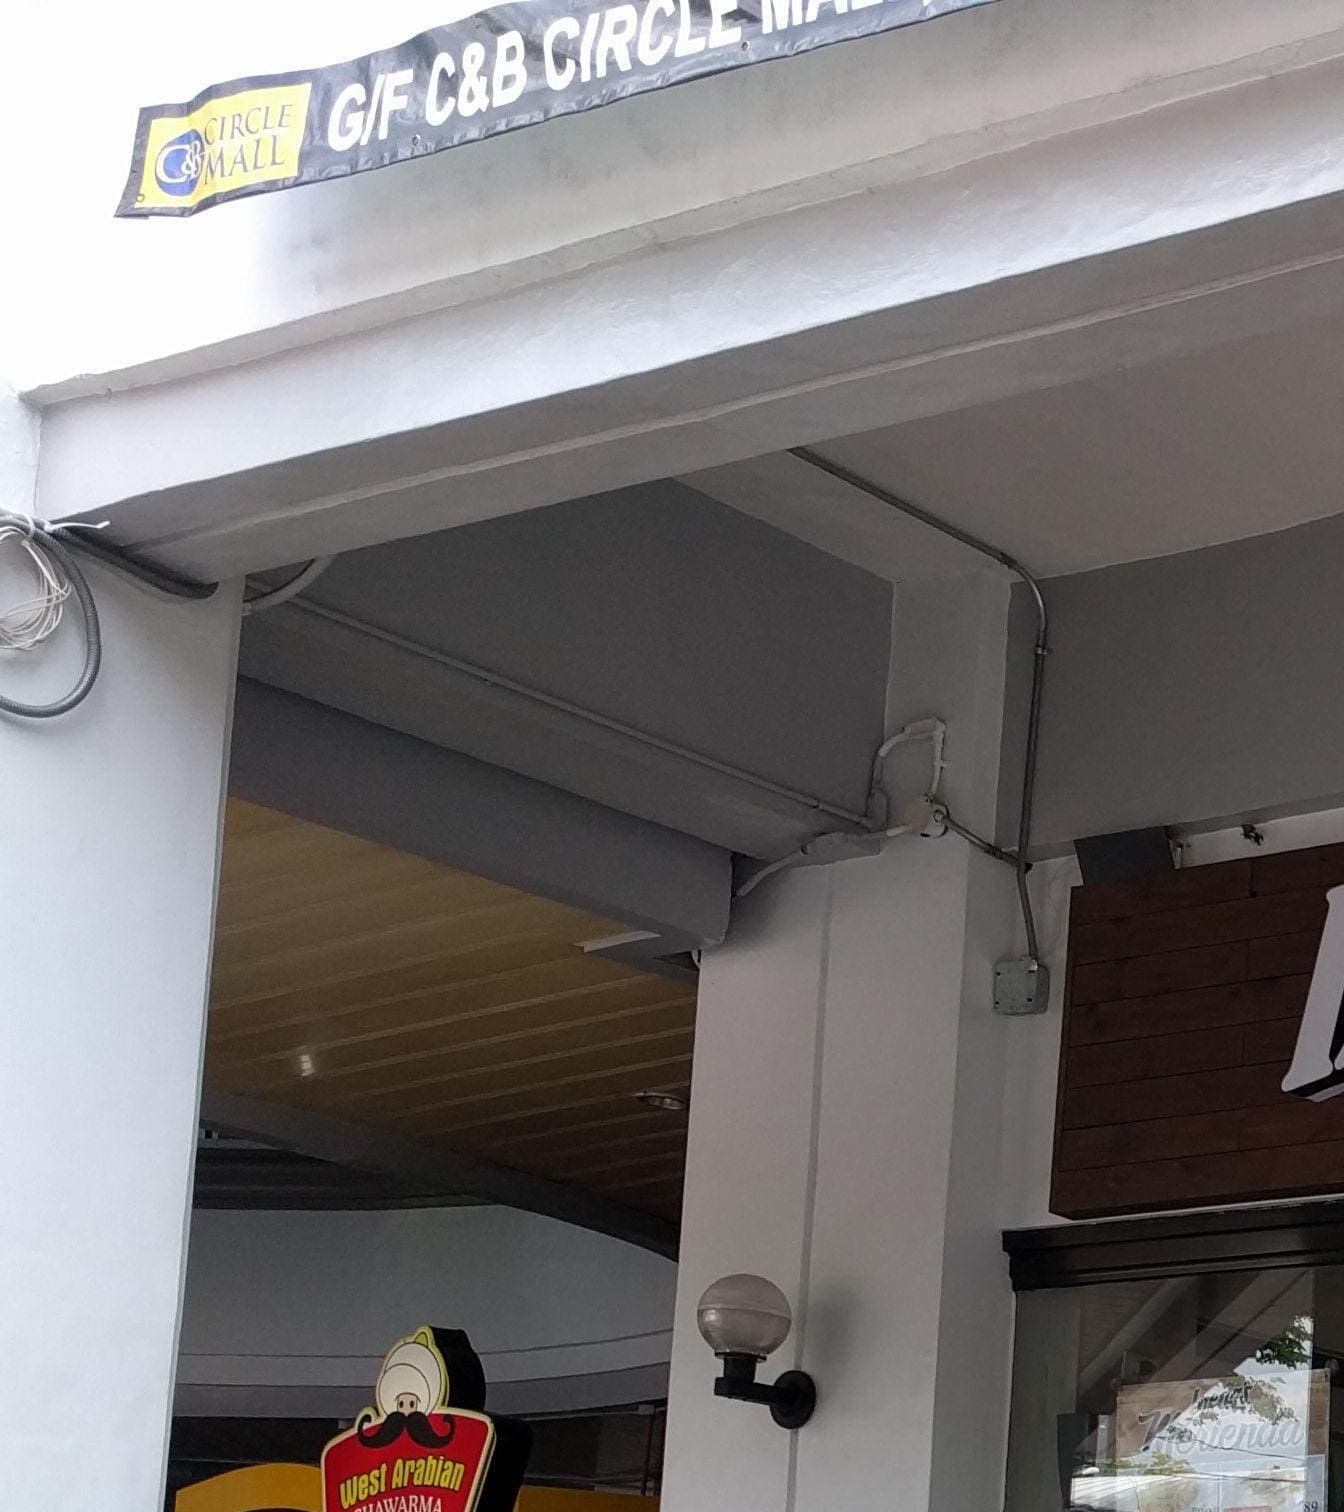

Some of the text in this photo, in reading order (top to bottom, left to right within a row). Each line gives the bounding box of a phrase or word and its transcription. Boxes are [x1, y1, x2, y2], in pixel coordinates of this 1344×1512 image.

[328, 0, 744, 151] G/F C&B CIRCLE
[204, 103, 293, 143] CIRCLE
[204, 134, 285, 186] MALL
[340, 1455, 465, 1509] West Arabian
